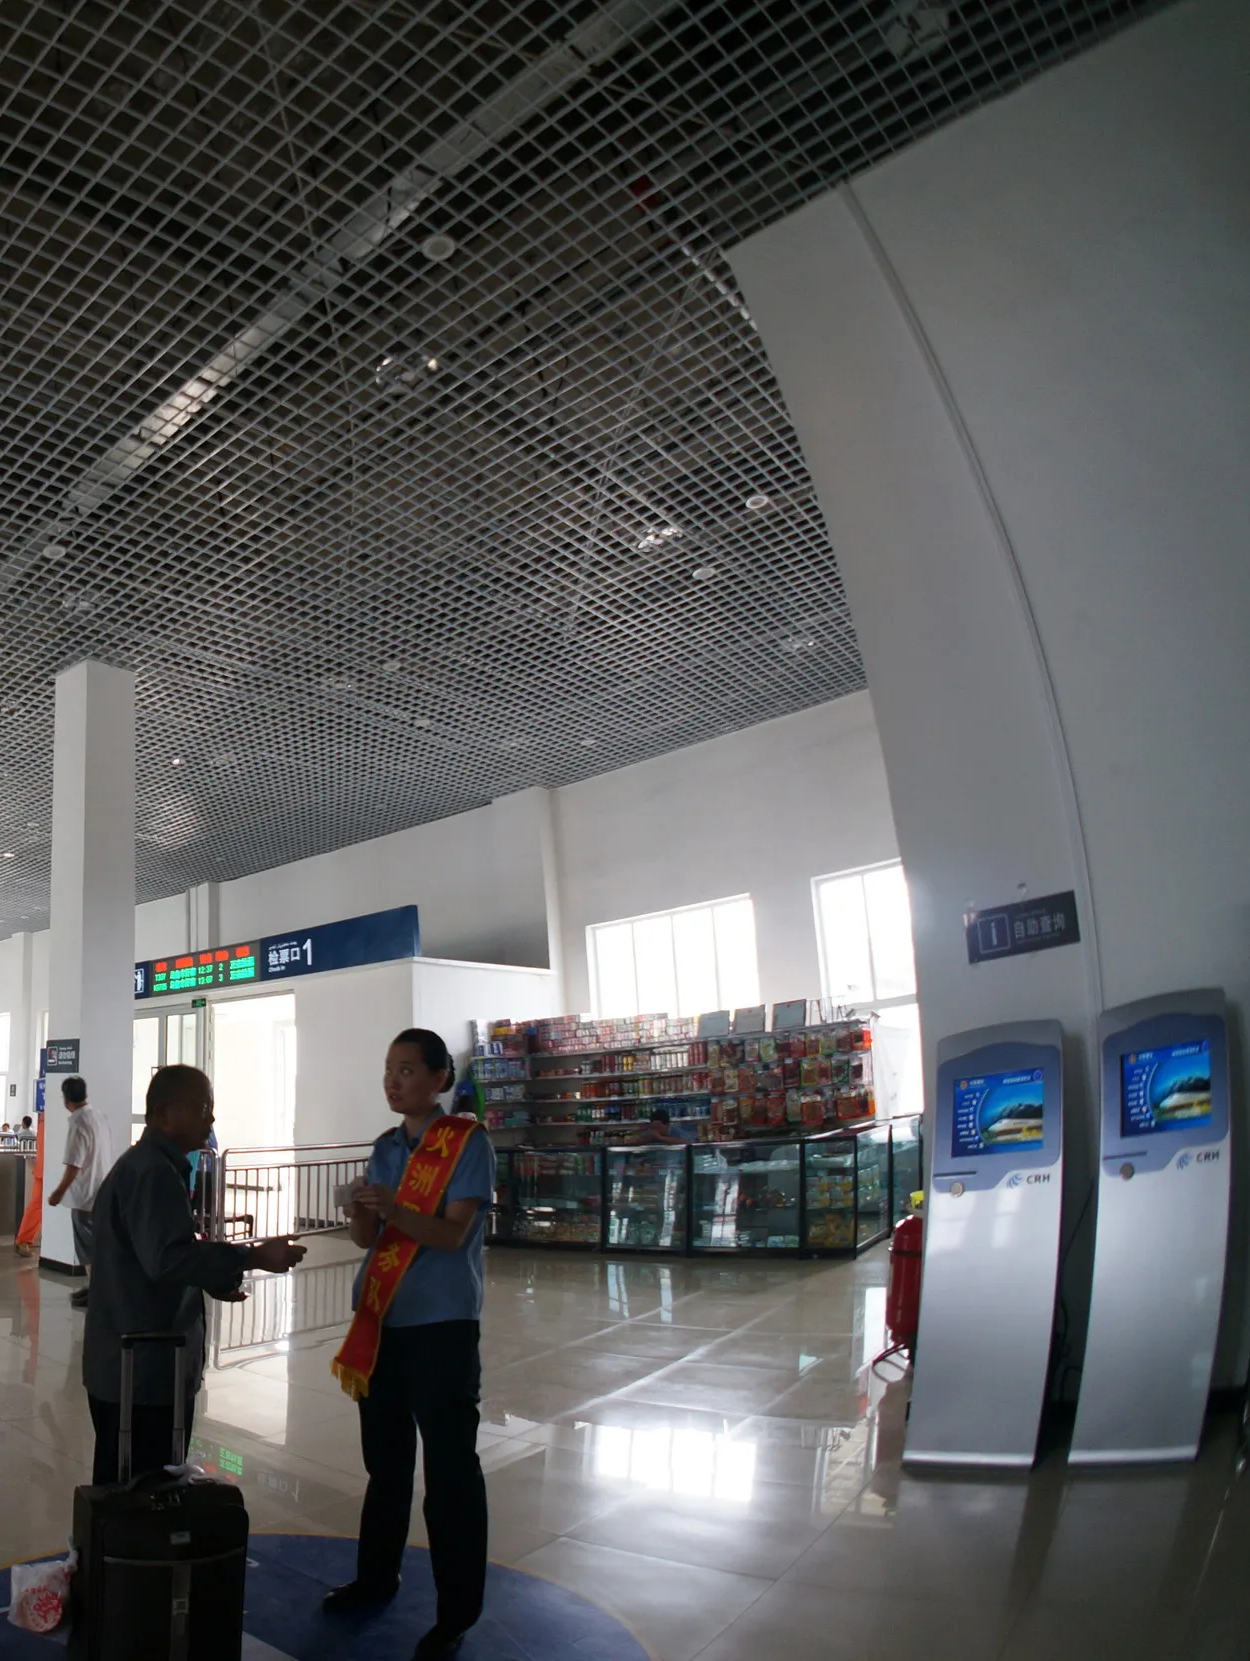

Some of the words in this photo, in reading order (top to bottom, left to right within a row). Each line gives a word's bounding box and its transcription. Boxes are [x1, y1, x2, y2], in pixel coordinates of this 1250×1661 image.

[1013, 911, 1066, 939] 自助查询
[267, 947, 300, 966] 检票口
[302, 938, 312, 966] 1
[218, 962, 224, 971] 2
[218, 973, 224, 982] 3
[1196, 1149, 1220, 1163] CRH
[1026, 1173, 1050, 1185] CRH
